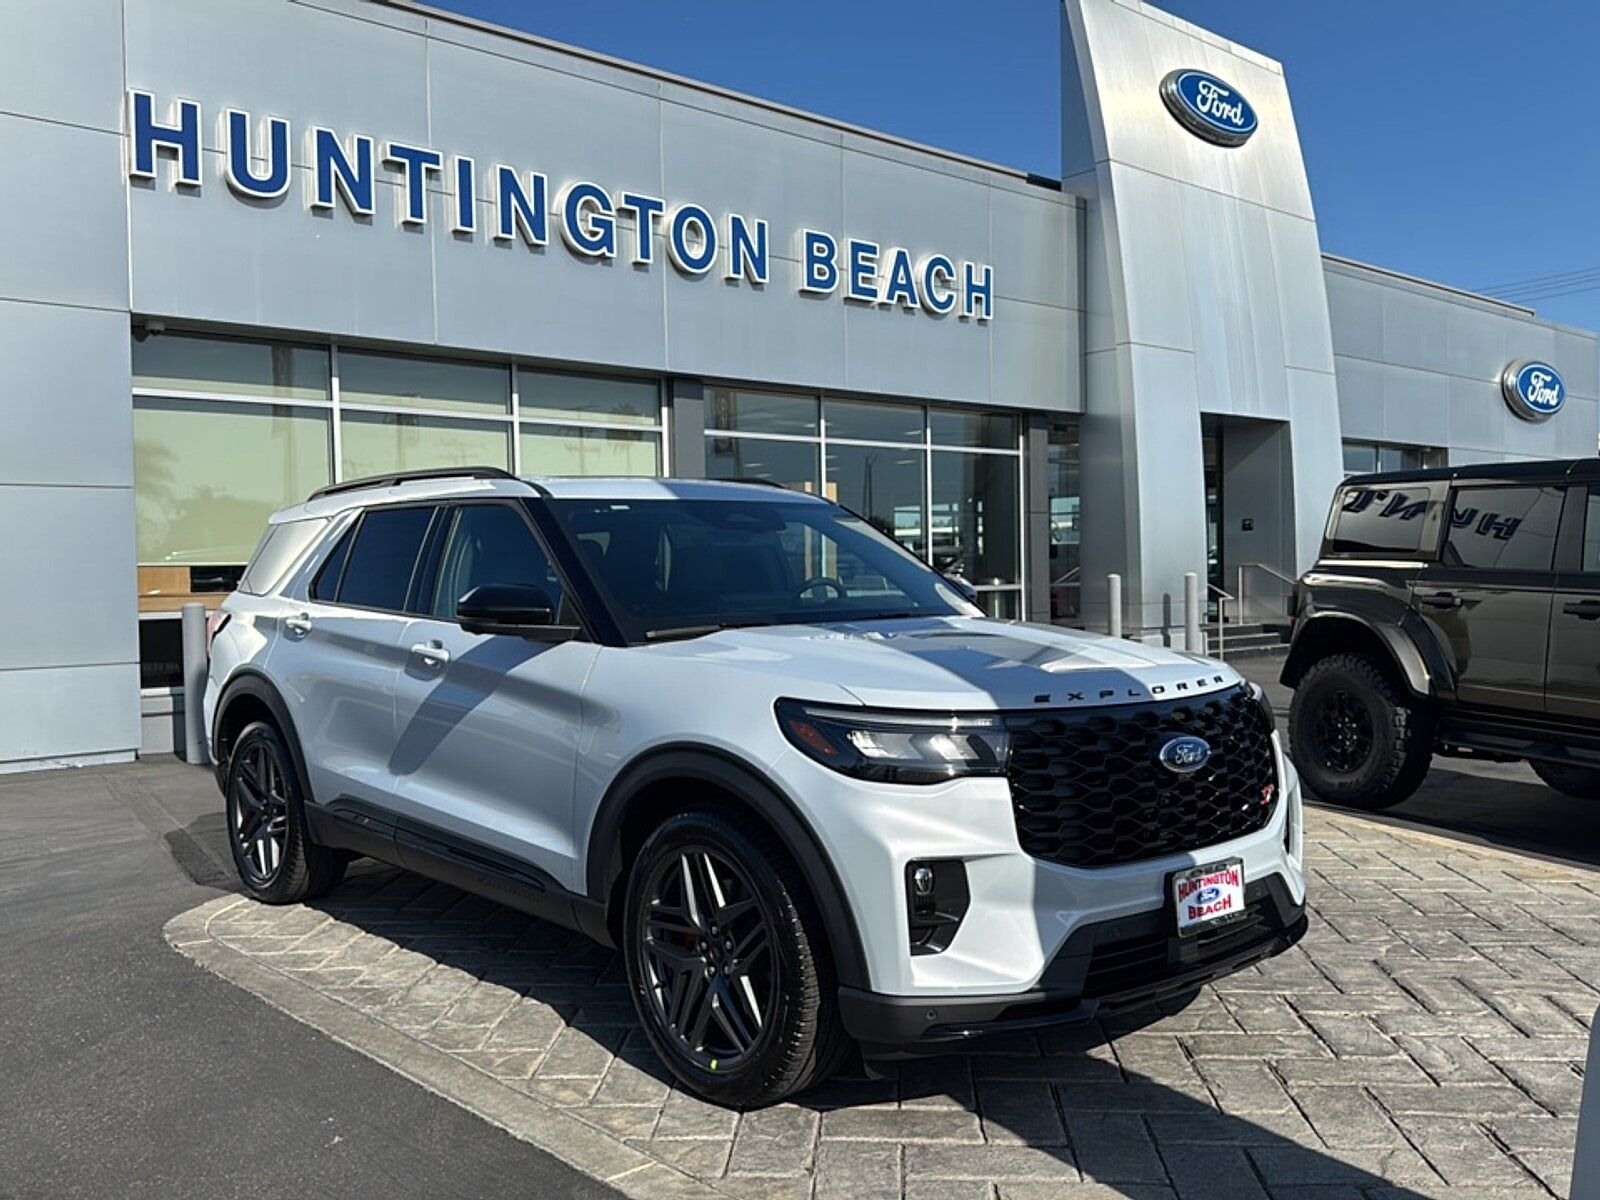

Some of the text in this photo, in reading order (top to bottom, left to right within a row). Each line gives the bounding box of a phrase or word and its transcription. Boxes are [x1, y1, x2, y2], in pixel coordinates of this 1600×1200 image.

[1196, 80, 1245, 126] Ford
[128, 89, 993, 320] HUNTINGTON BEACH
[1527, 371, 1560, 406] Ford
[1034, 674, 1224, 703] EXPLORER
[1175, 743, 1204, 765] Ford
[1178, 869, 1240, 903] HUNTINGTON
[1188, 894, 1232, 920] BEACH
